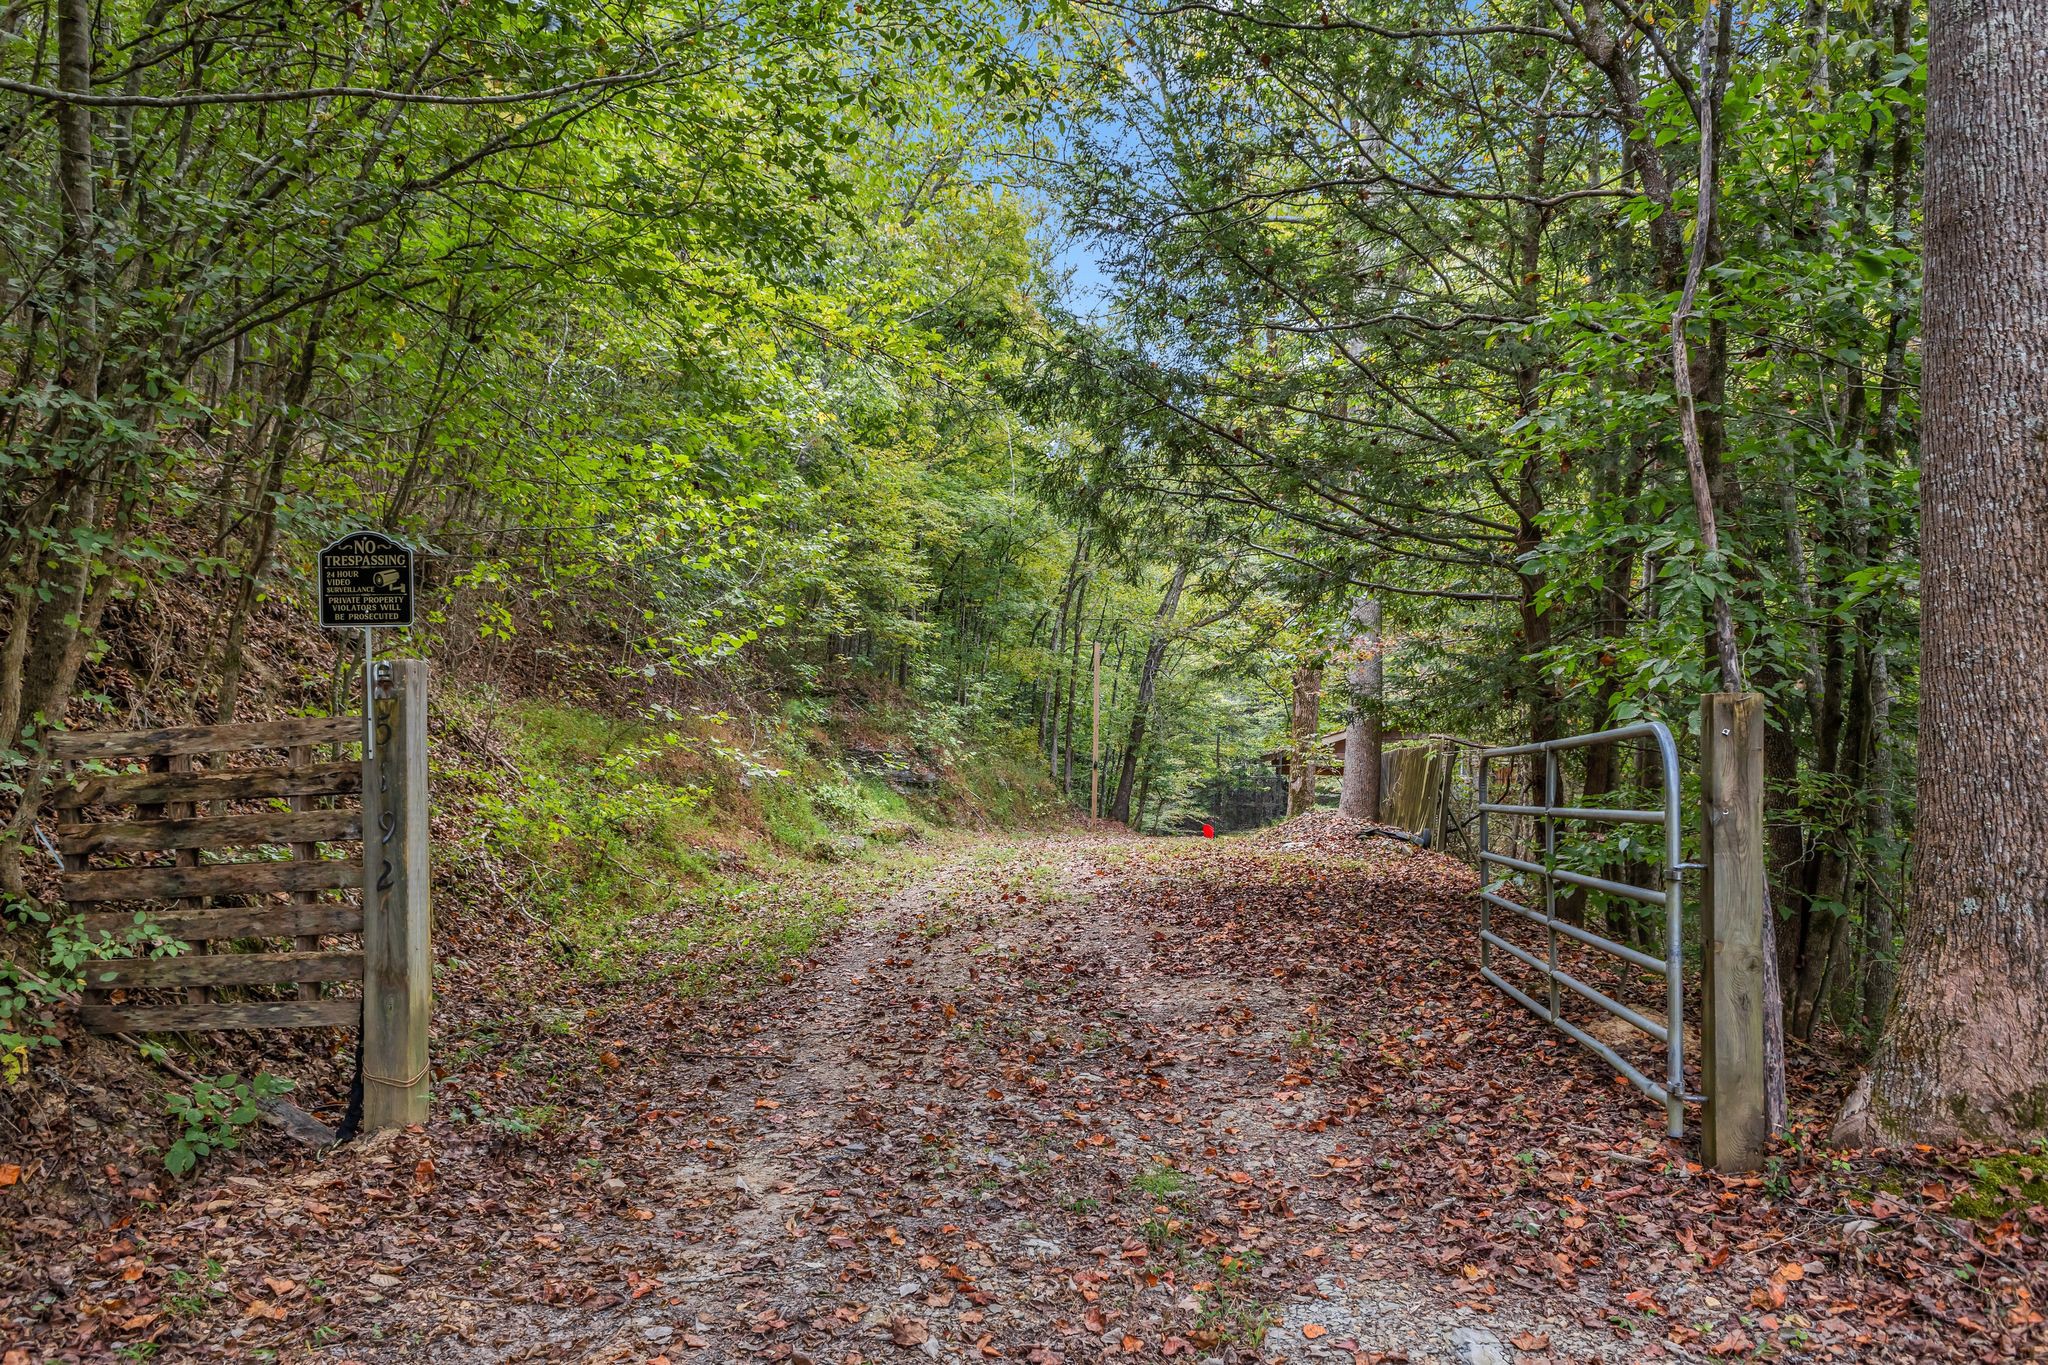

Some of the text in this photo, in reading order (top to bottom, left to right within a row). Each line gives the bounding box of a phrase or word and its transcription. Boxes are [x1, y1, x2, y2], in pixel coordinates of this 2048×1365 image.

[354, 540, 376, 554] NO
[325, 555, 406, 566] TRESPASSING
[336, 570, 359, 578] HOUR
[328, 596, 361, 604] PRIVATE
[332, 603, 402, 612] VIOLATORS WILL
[348, 612, 399, 620] PROSECUTED
